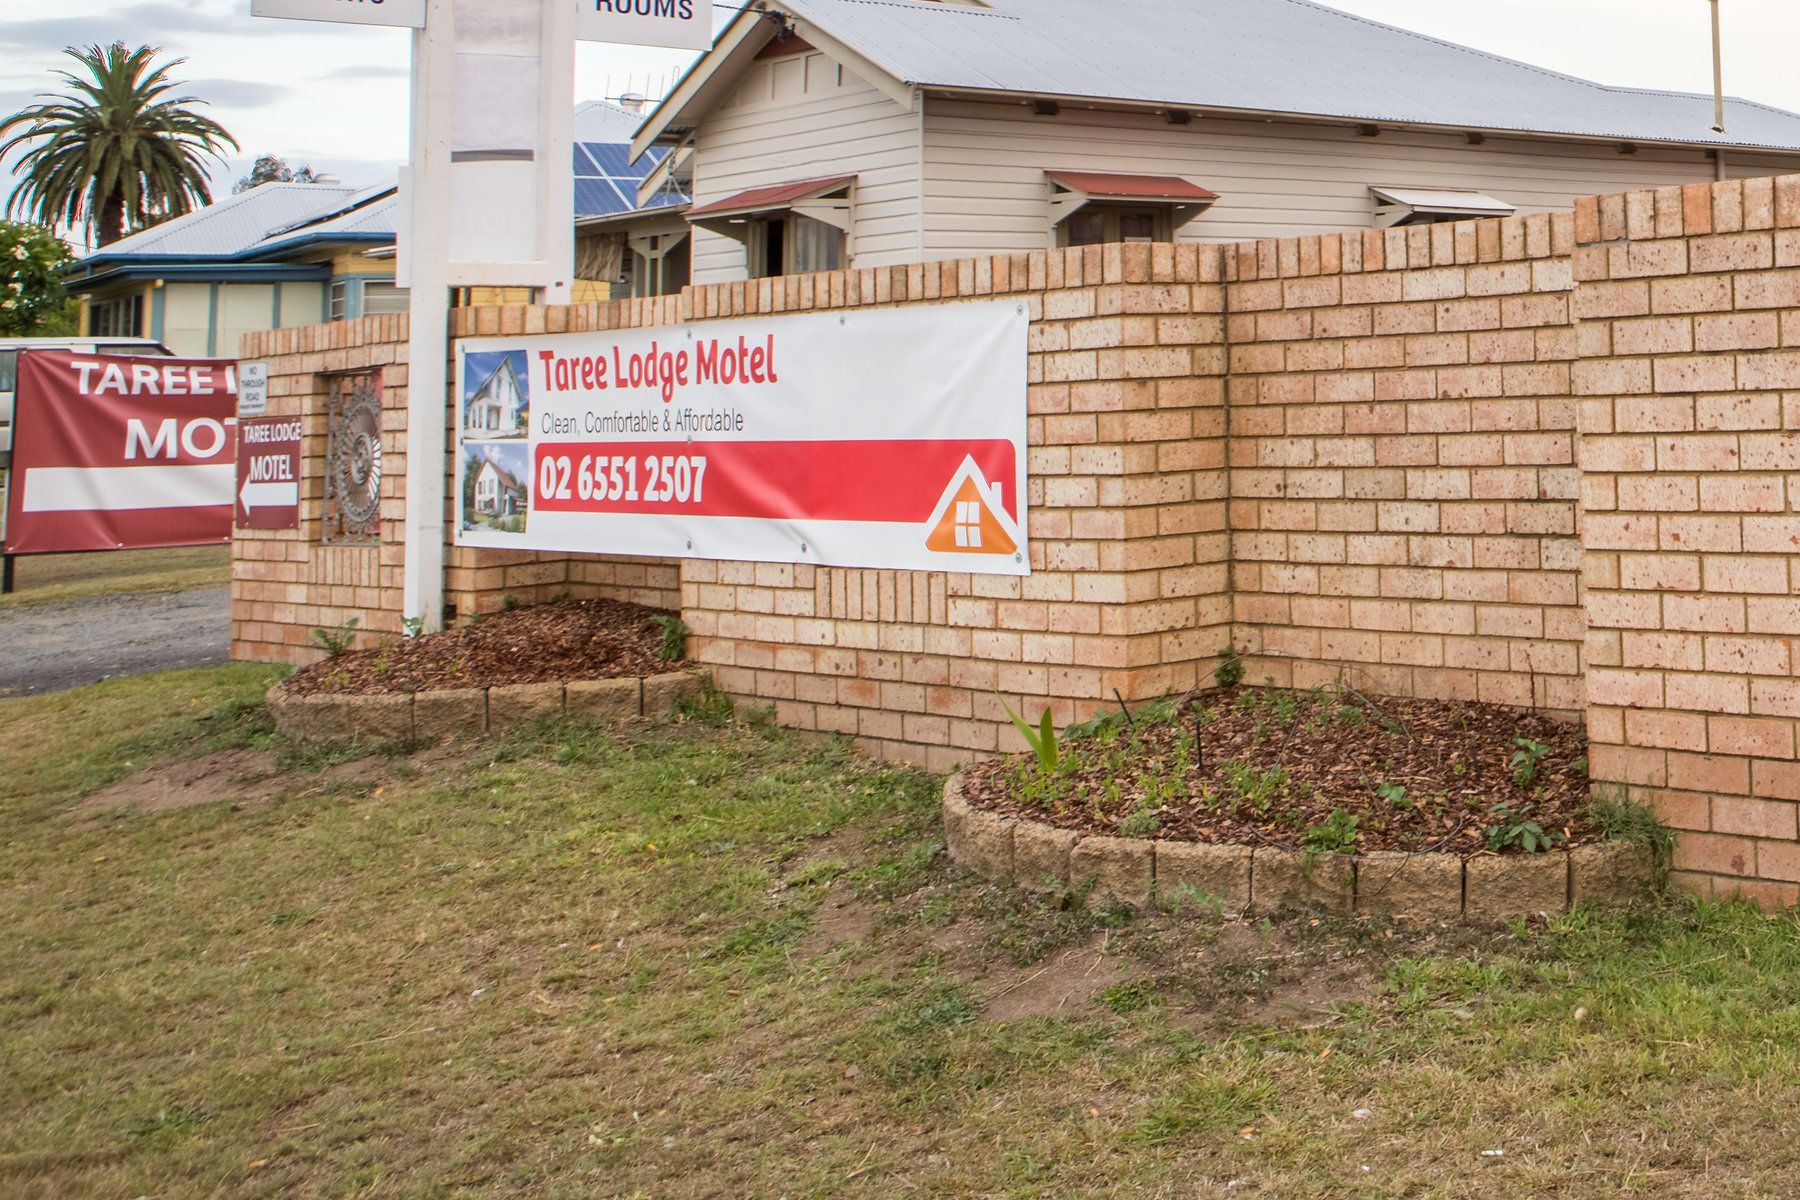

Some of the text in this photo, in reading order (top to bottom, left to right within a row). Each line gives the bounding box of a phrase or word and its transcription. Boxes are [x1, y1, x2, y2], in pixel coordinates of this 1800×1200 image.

[70, 361, 214, 396] TAREE
[538, 333, 778, 404] Taree Lodge Motel
[243, 422, 301, 443] TAREE LODGE
[541, 407, 744, 438] Clean, Comfortable & Affordable
[250, 454, 294, 481] MOTEL
[539, 455, 707, 503] 02 6551 2507
